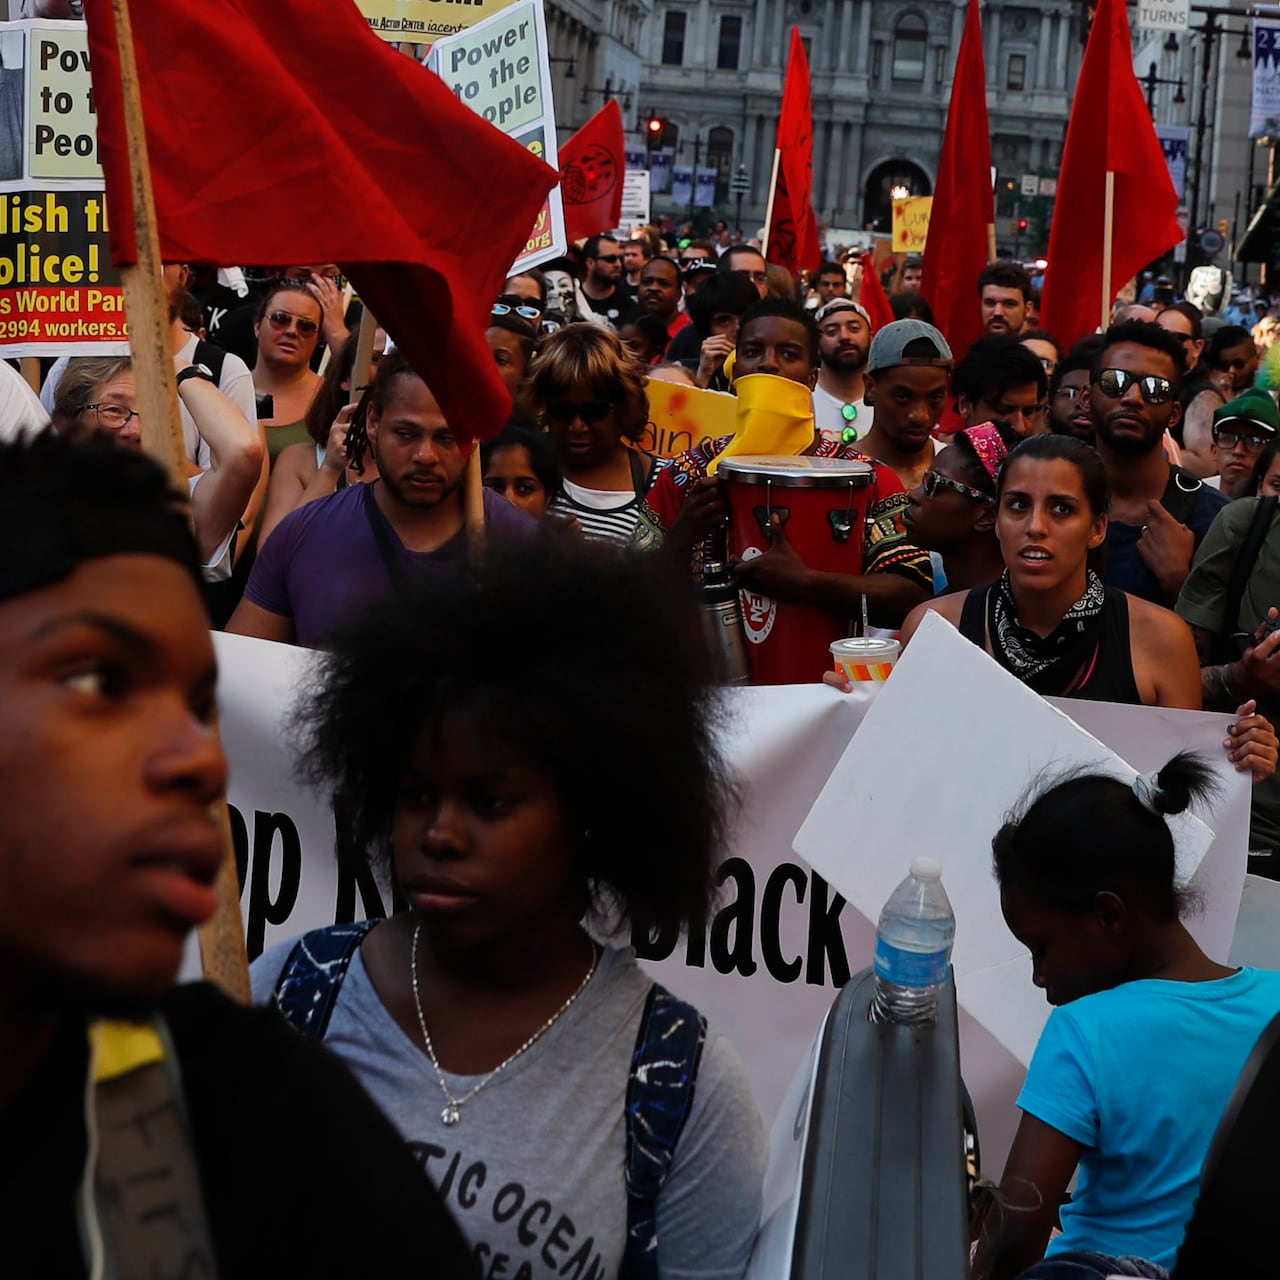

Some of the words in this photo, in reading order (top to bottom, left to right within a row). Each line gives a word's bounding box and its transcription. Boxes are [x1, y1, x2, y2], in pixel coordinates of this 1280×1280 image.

[1141, 8, 1186, 25] TURNS
[451, 20, 529, 73] Power
[40, 86, 73, 114] to
[453, 81, 480, 104] to
[489, 55, 530, 91] the
[482, 84, 537, 125] ople
[34, 124, 102, 165] Peo
[16, 290, 79, 315] World
[88, 290, 125, 313] Par
